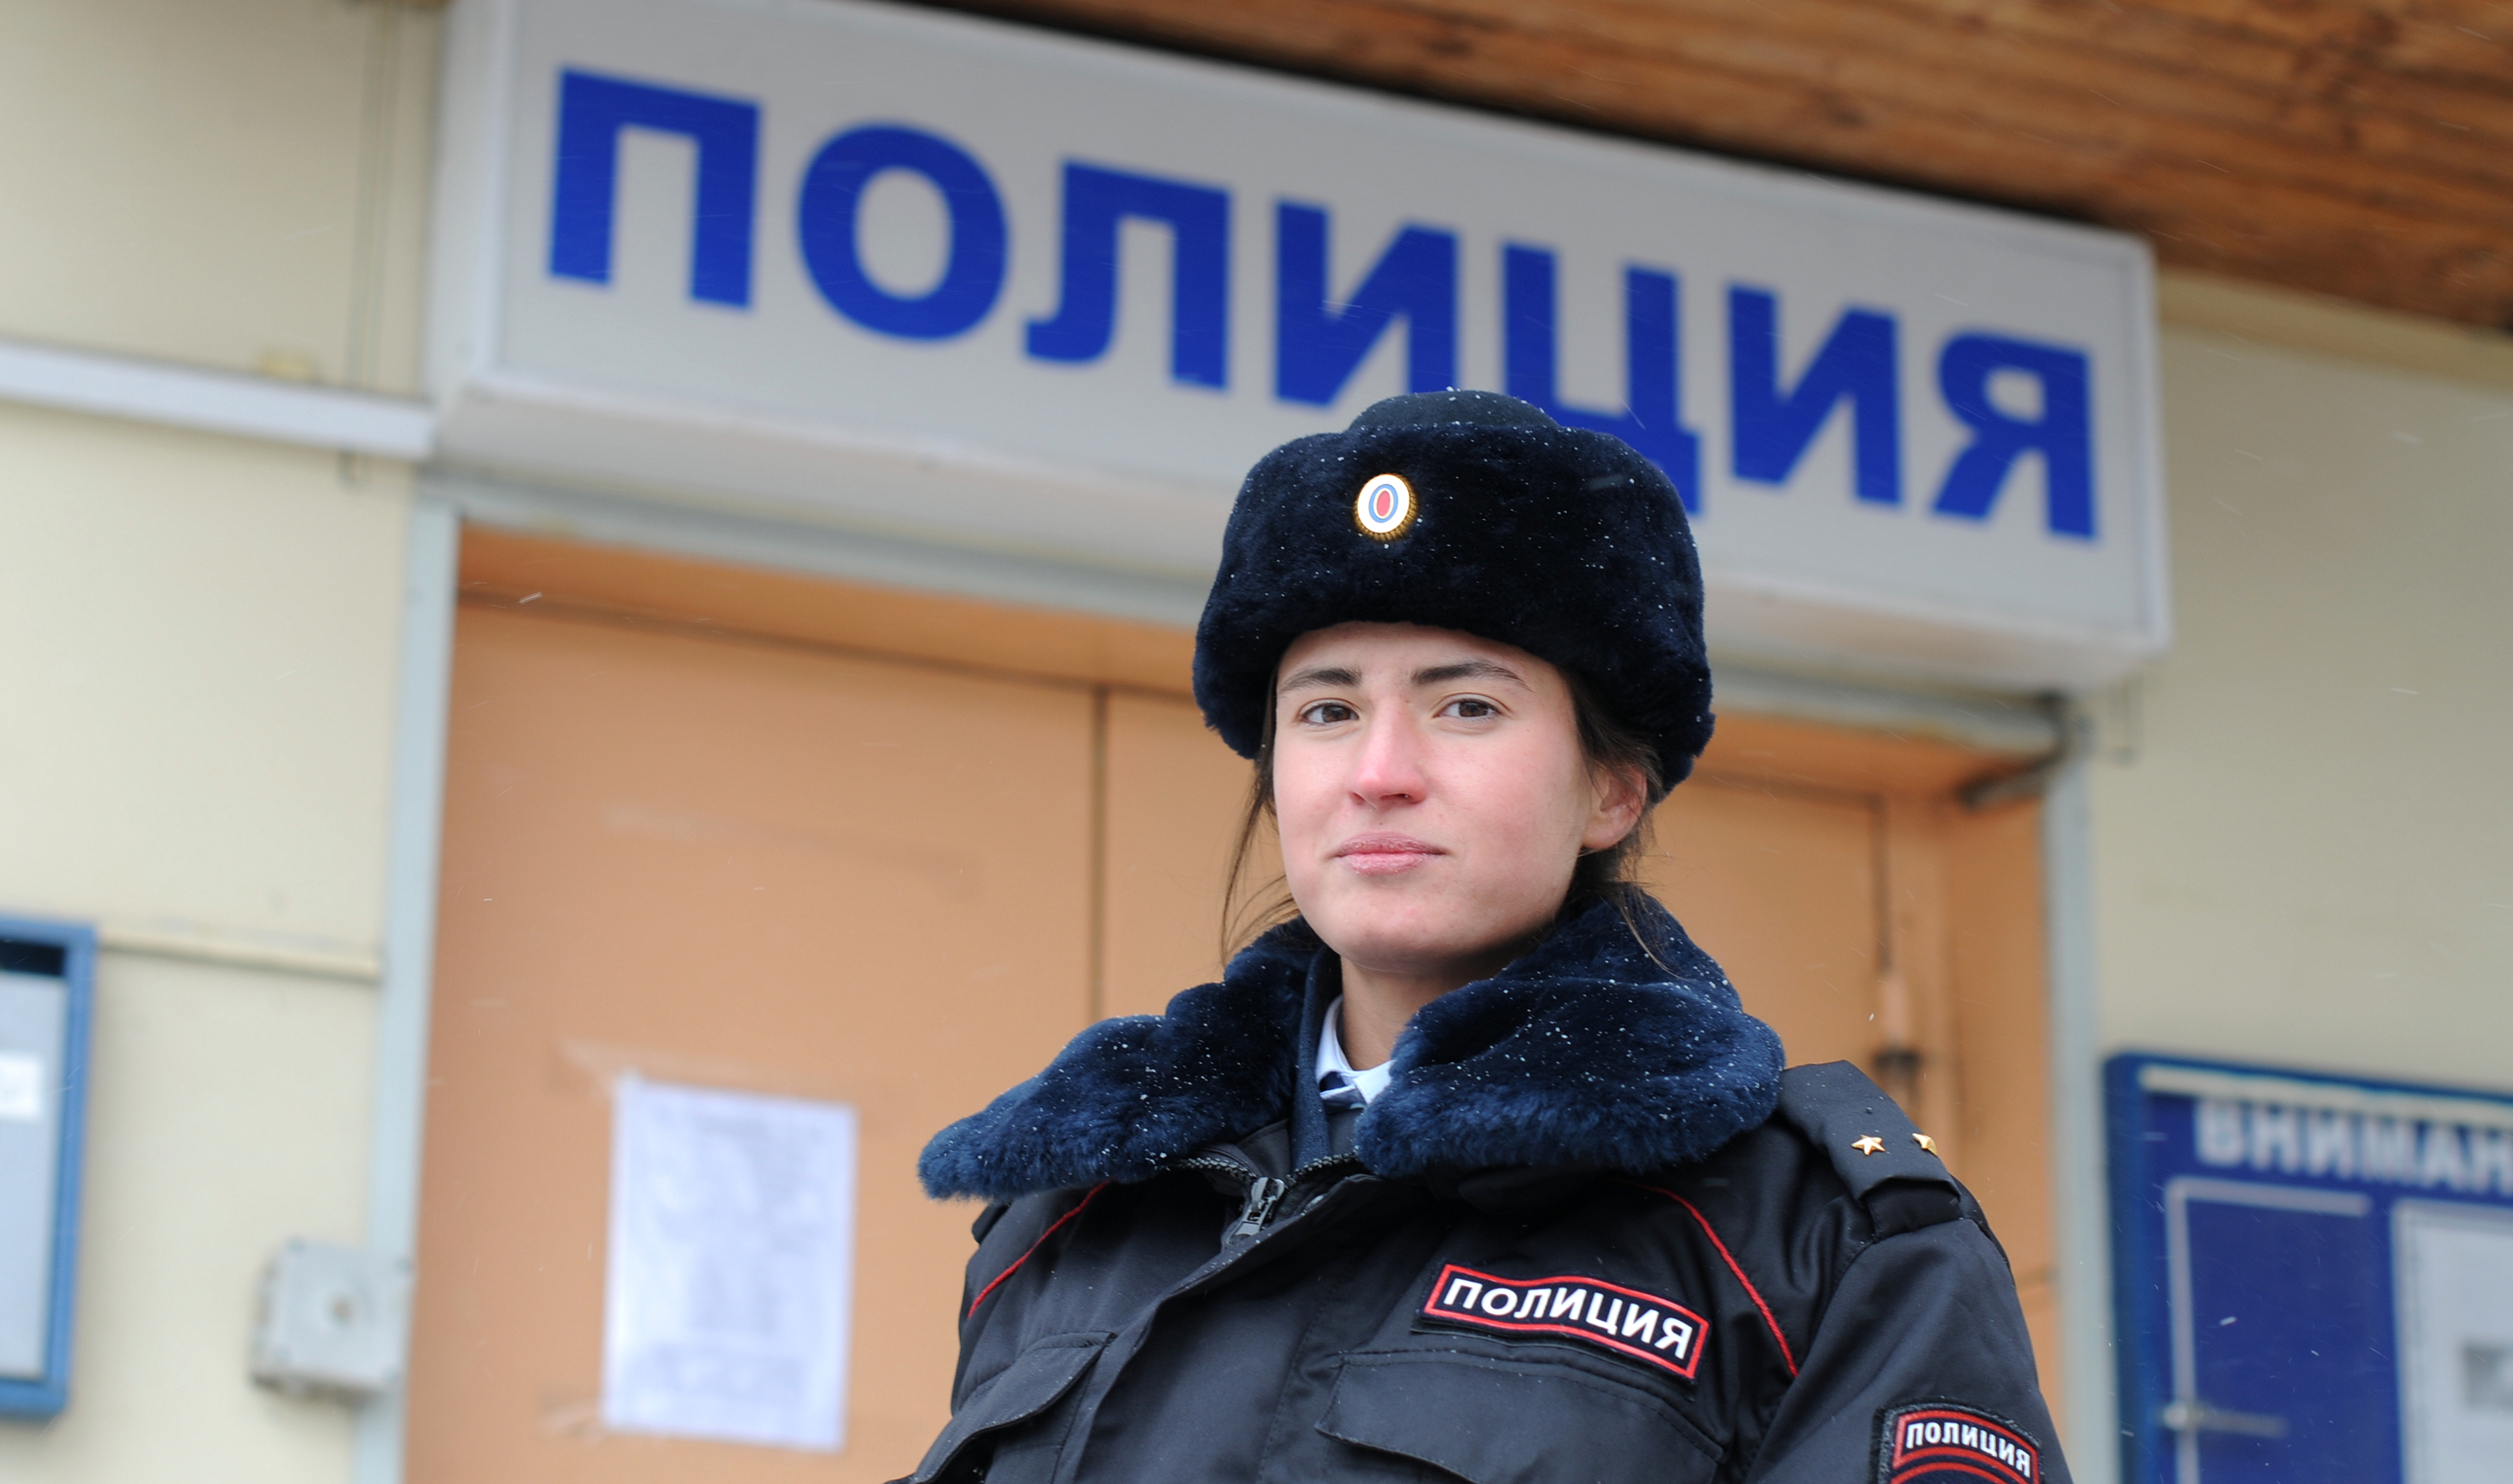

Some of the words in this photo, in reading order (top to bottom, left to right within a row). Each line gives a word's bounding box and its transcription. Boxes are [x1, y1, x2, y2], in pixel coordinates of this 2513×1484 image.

[547, 69, 2098, 541] ПОЛИЦИЯ
[1443, 1278, 1693, 1359] ПОЛИЦИЯ
[1906, 1421, 2031, 1478] ПОЛИЦИЯ
